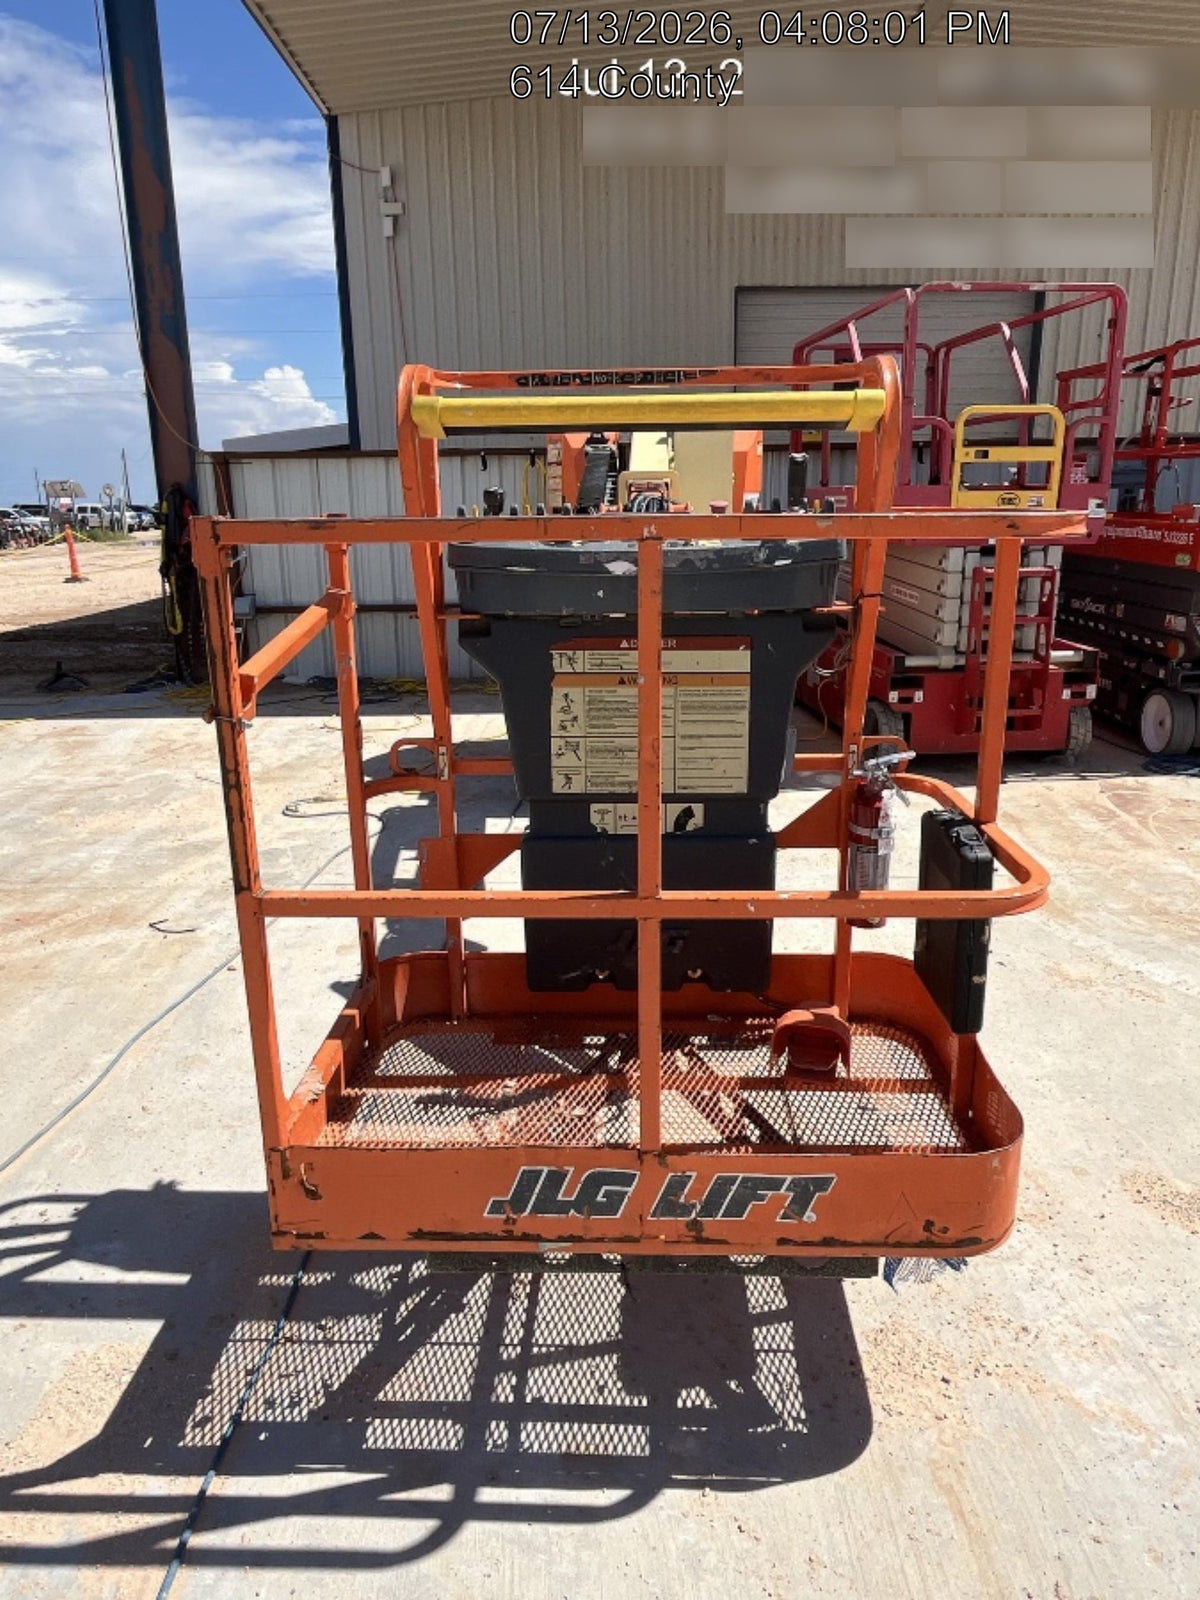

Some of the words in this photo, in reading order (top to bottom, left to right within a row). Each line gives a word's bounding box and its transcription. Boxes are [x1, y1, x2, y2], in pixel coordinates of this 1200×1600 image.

[630, 639, 677, 648] DER
[484, 1166, 641, 1219] JLG
[647, 1171, 838, 1223] LIFT
